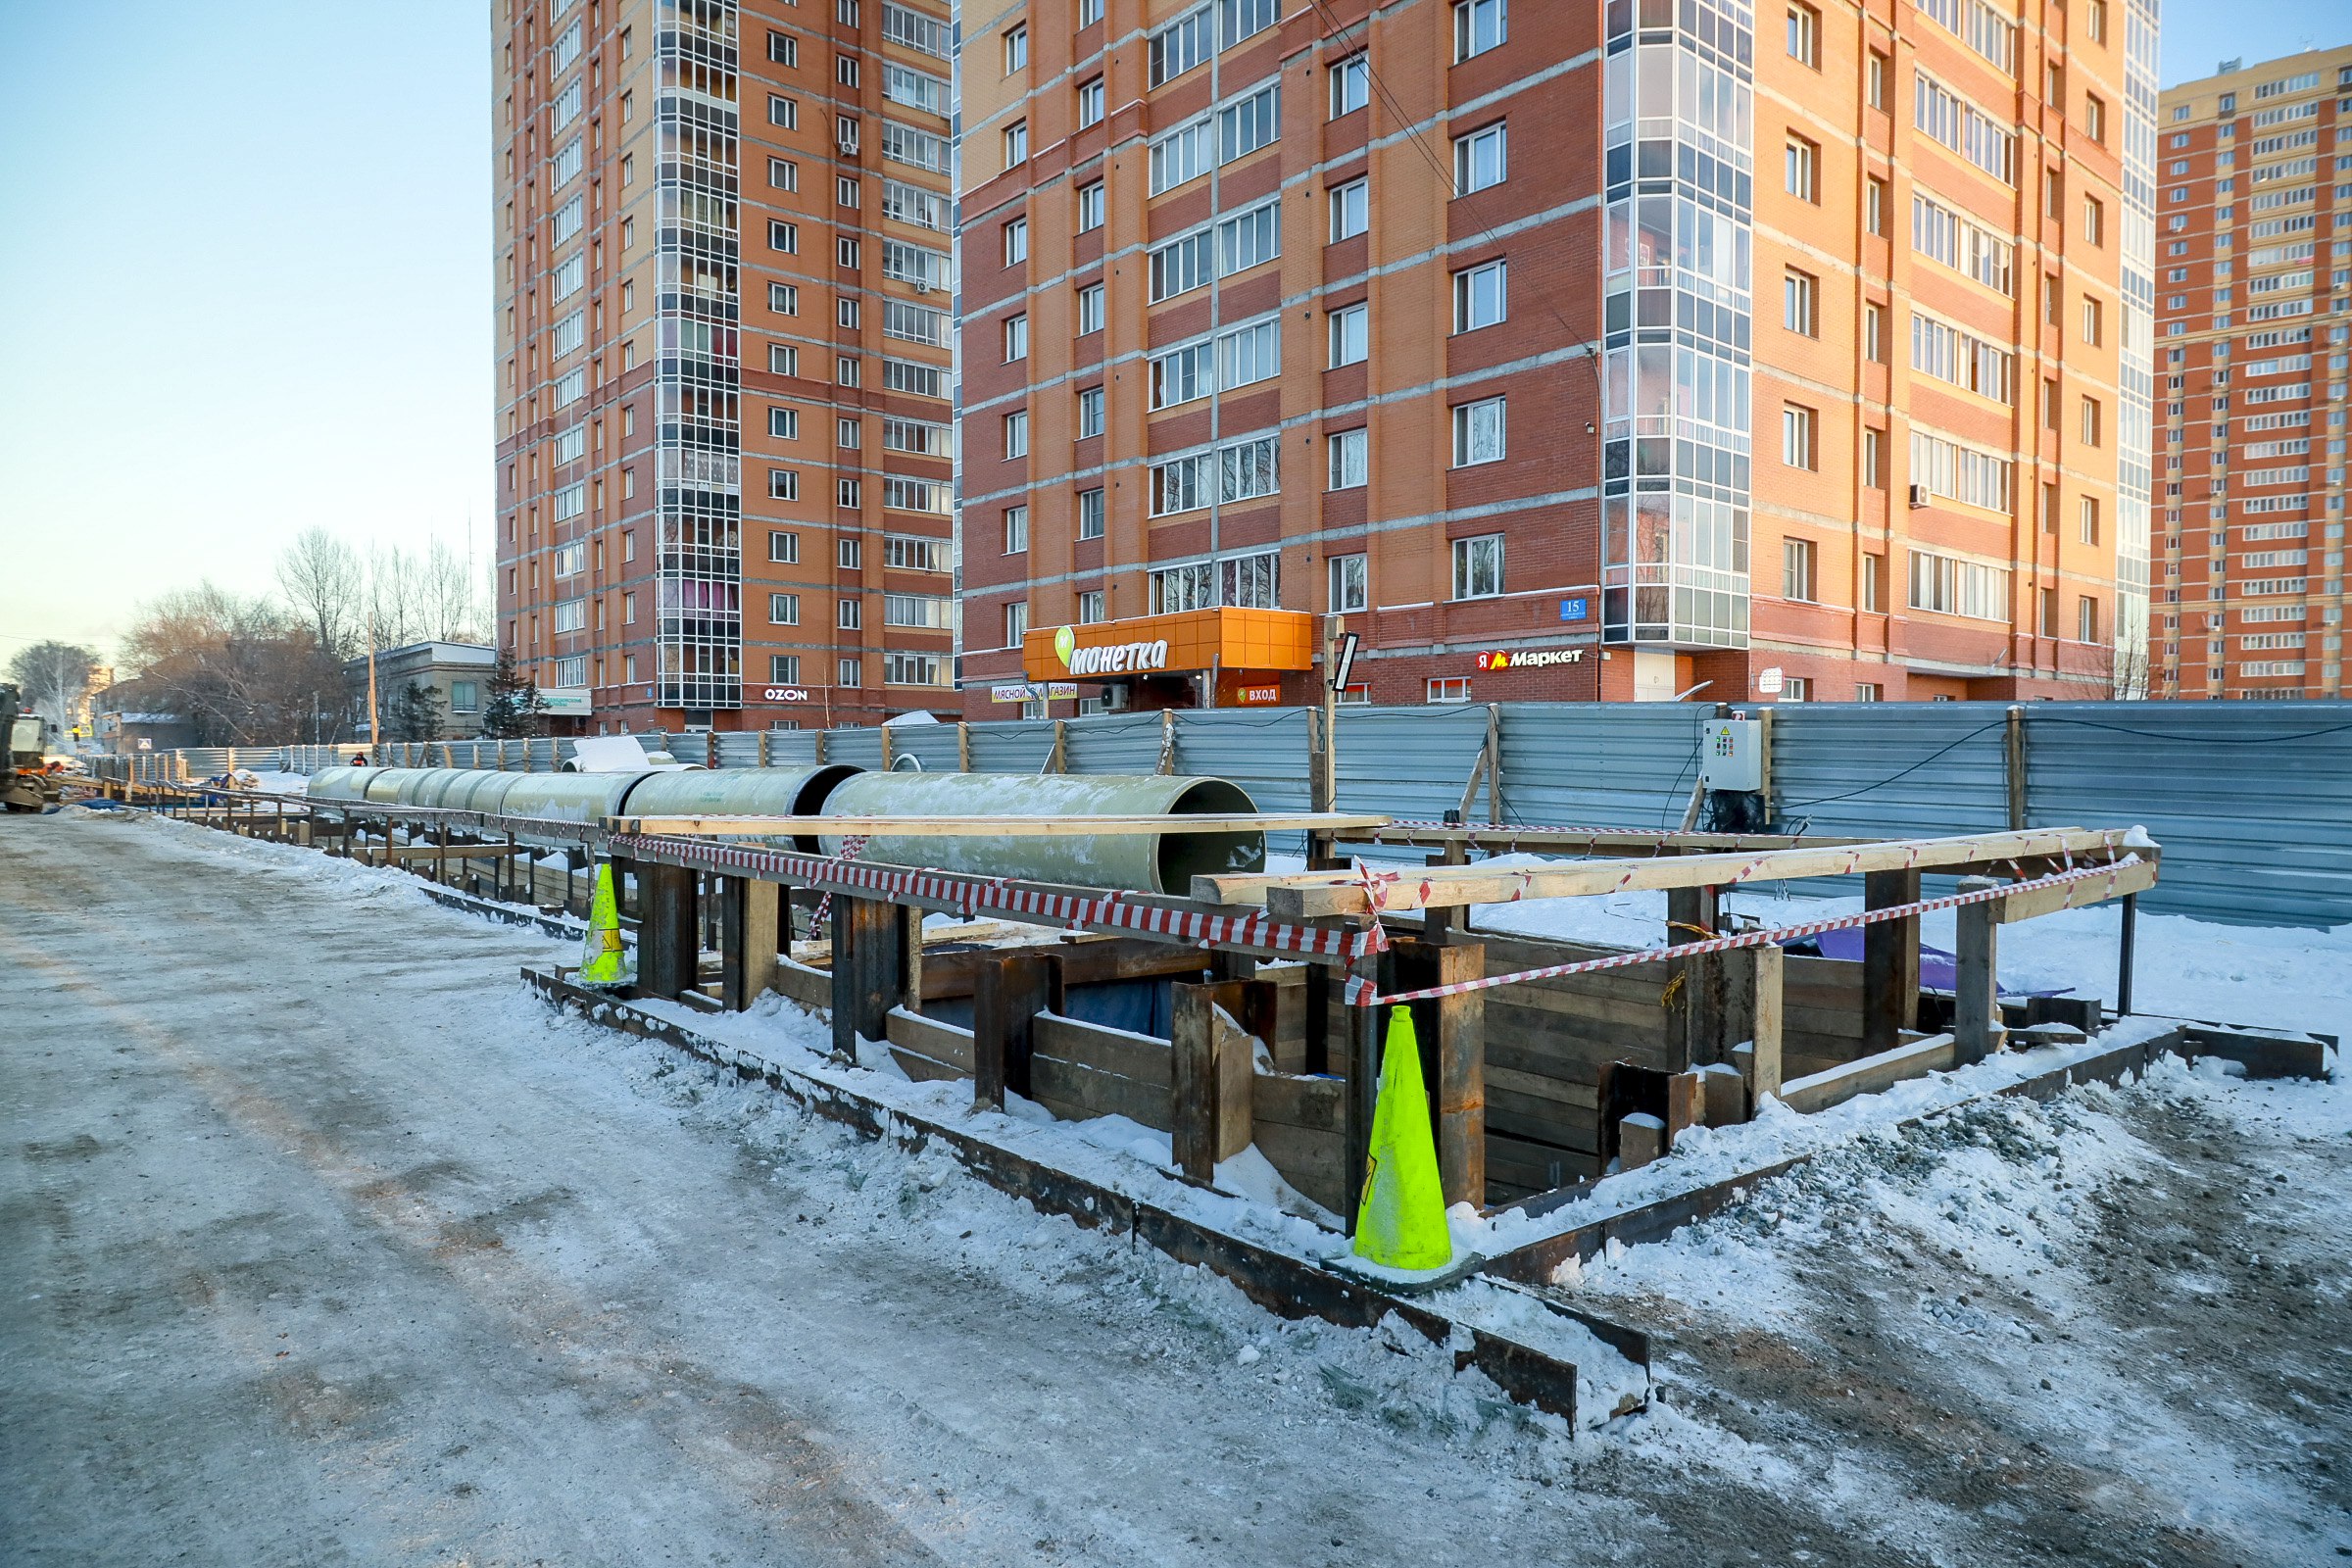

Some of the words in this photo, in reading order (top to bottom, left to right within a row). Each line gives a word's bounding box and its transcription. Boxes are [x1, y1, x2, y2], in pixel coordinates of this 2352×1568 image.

[1568, 600, 1579, 612] 15
[1479, 654, 1488, 668] Я
[1509, 650, 1584, 666] Маркет
[764, 688, 808, 701] OZON
[994, 687, 1026, 700] МЯСНОЙ
[1250, 689, 1276, 702] ВХОД
